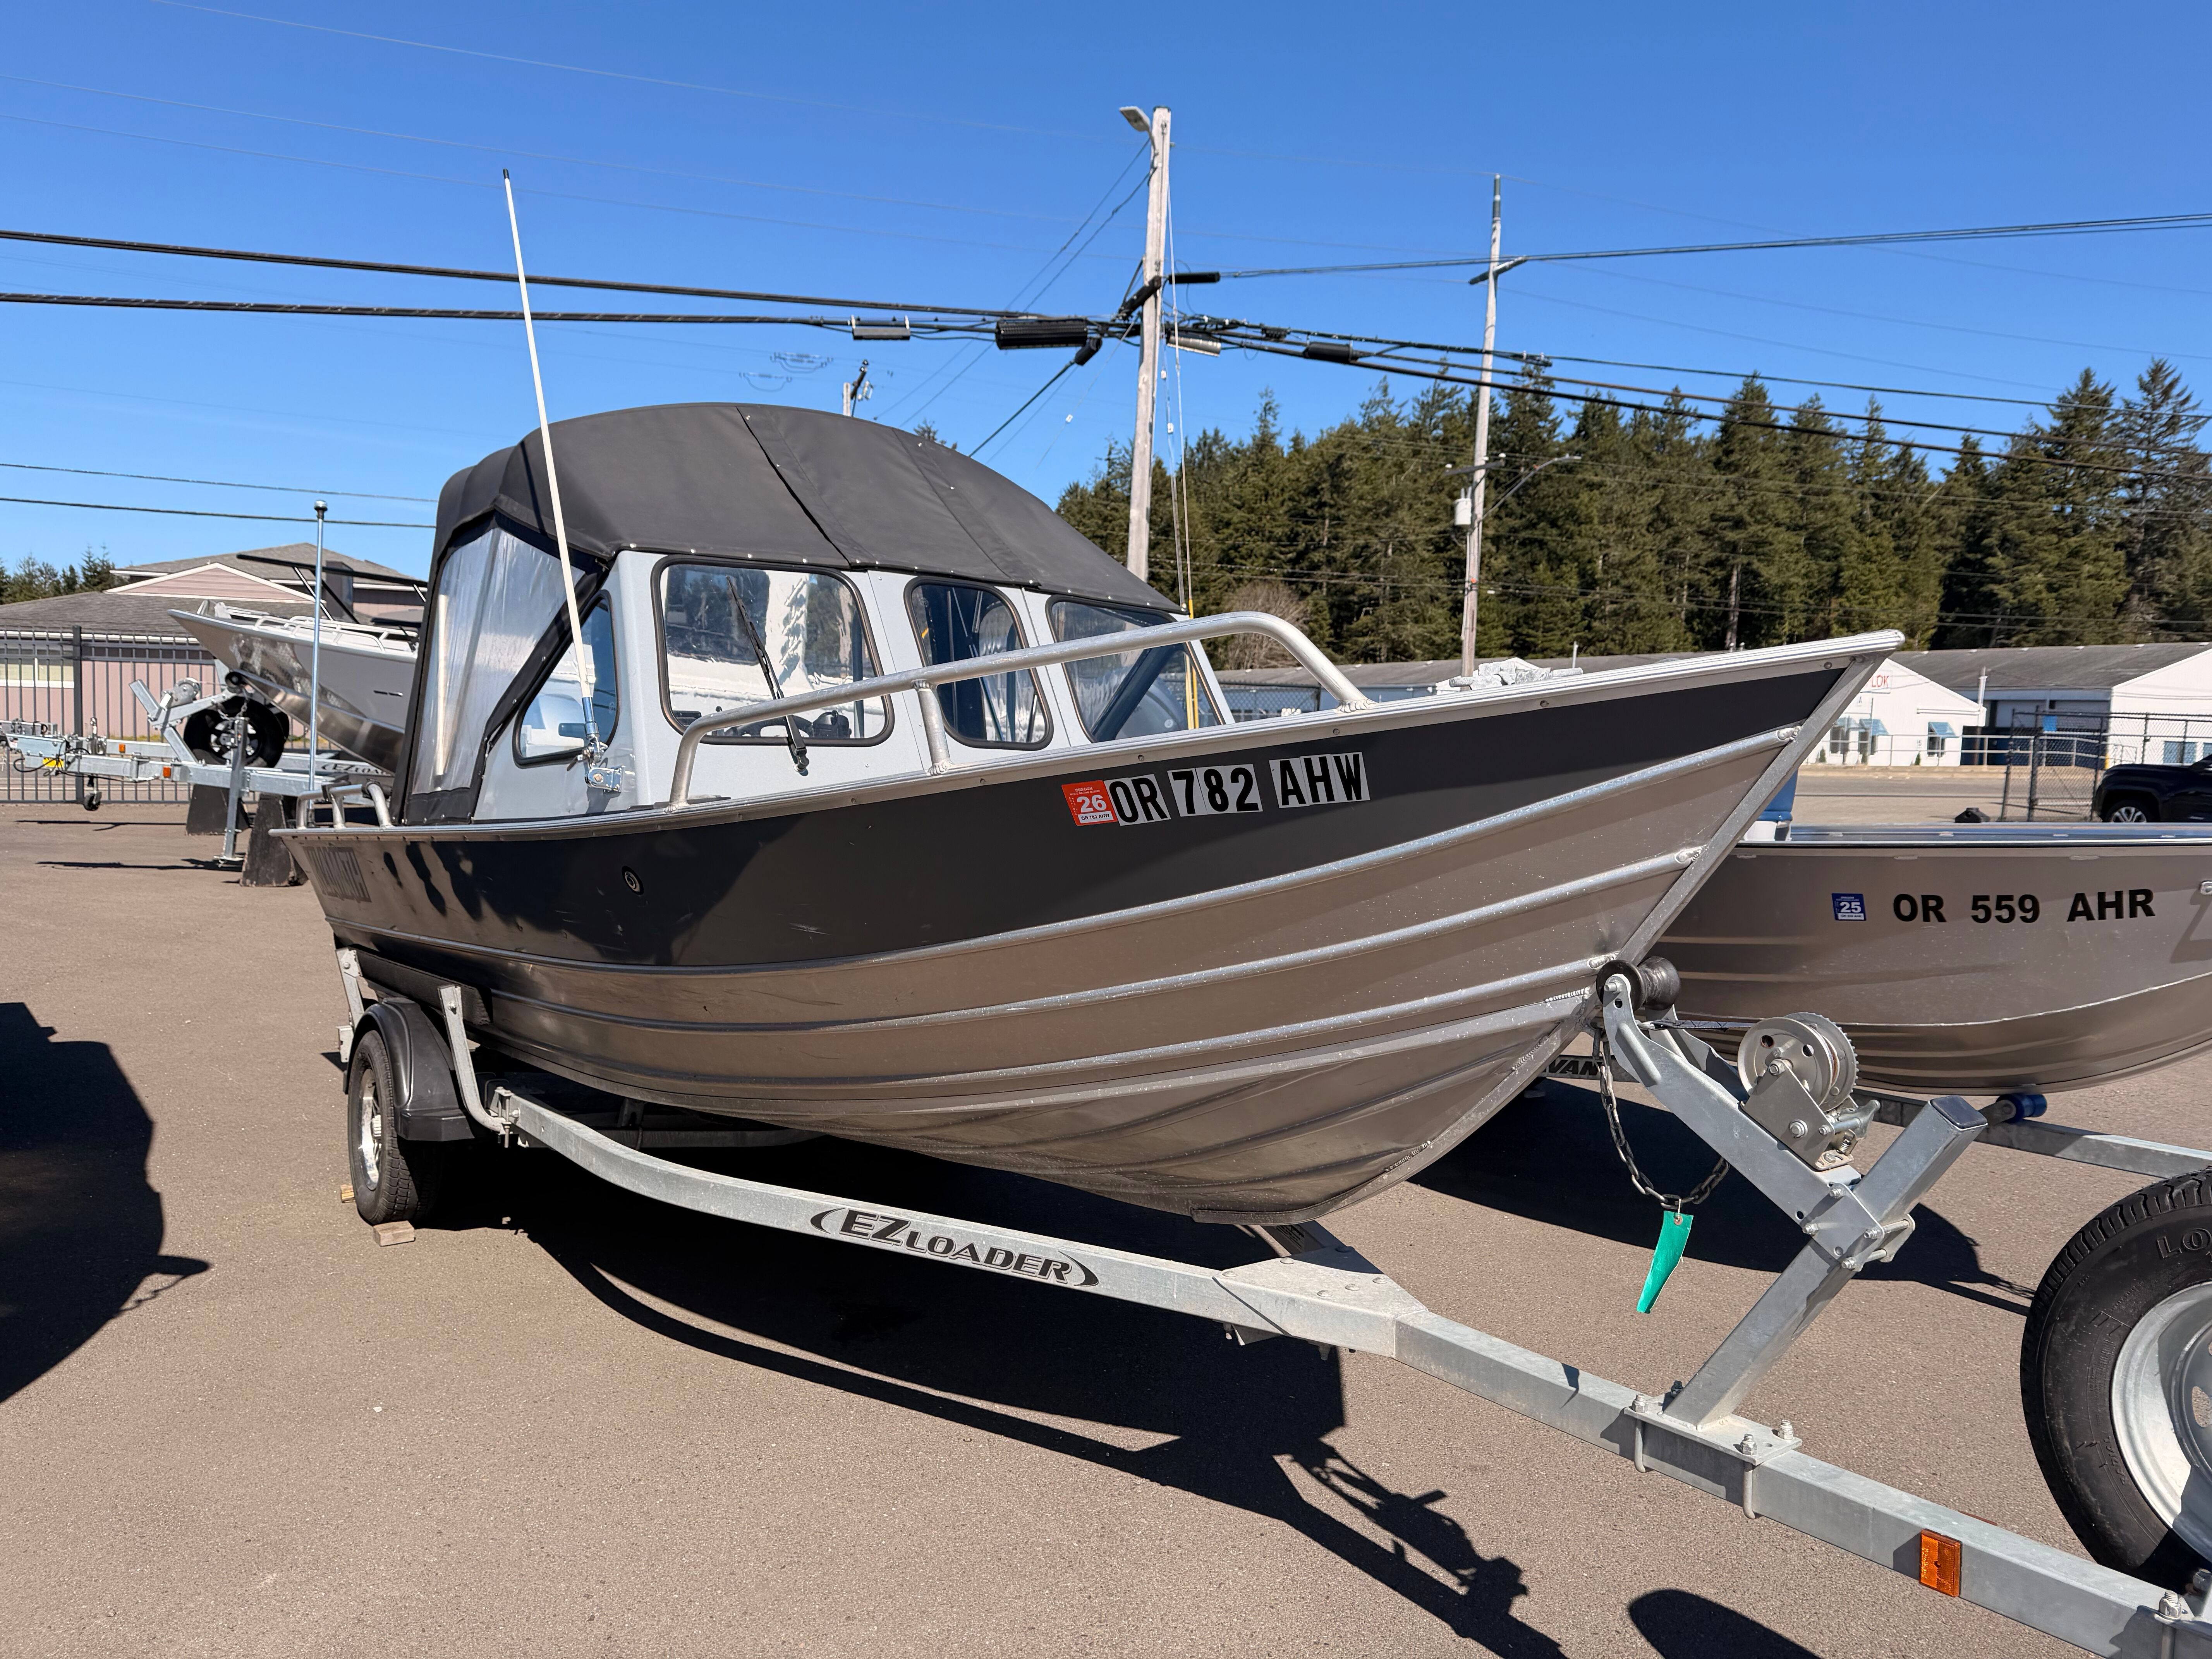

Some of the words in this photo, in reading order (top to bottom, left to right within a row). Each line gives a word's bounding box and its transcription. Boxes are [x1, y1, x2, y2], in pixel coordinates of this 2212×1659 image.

[1109, 778, 1168, 823] OR
[1173, 767, 1259, 814] 782
[1279, 754, 1363, 806] AHW
[1077, 794, 1107, 813] 26
[1839, 902, 1862, 913] 25
[1893, 893, 1947, 922] OR
[1971, 894, 2040, 923] 559
[2067, 888, 2155, 922] AHR
[1543, 1059, 1603, 1076] VAN
